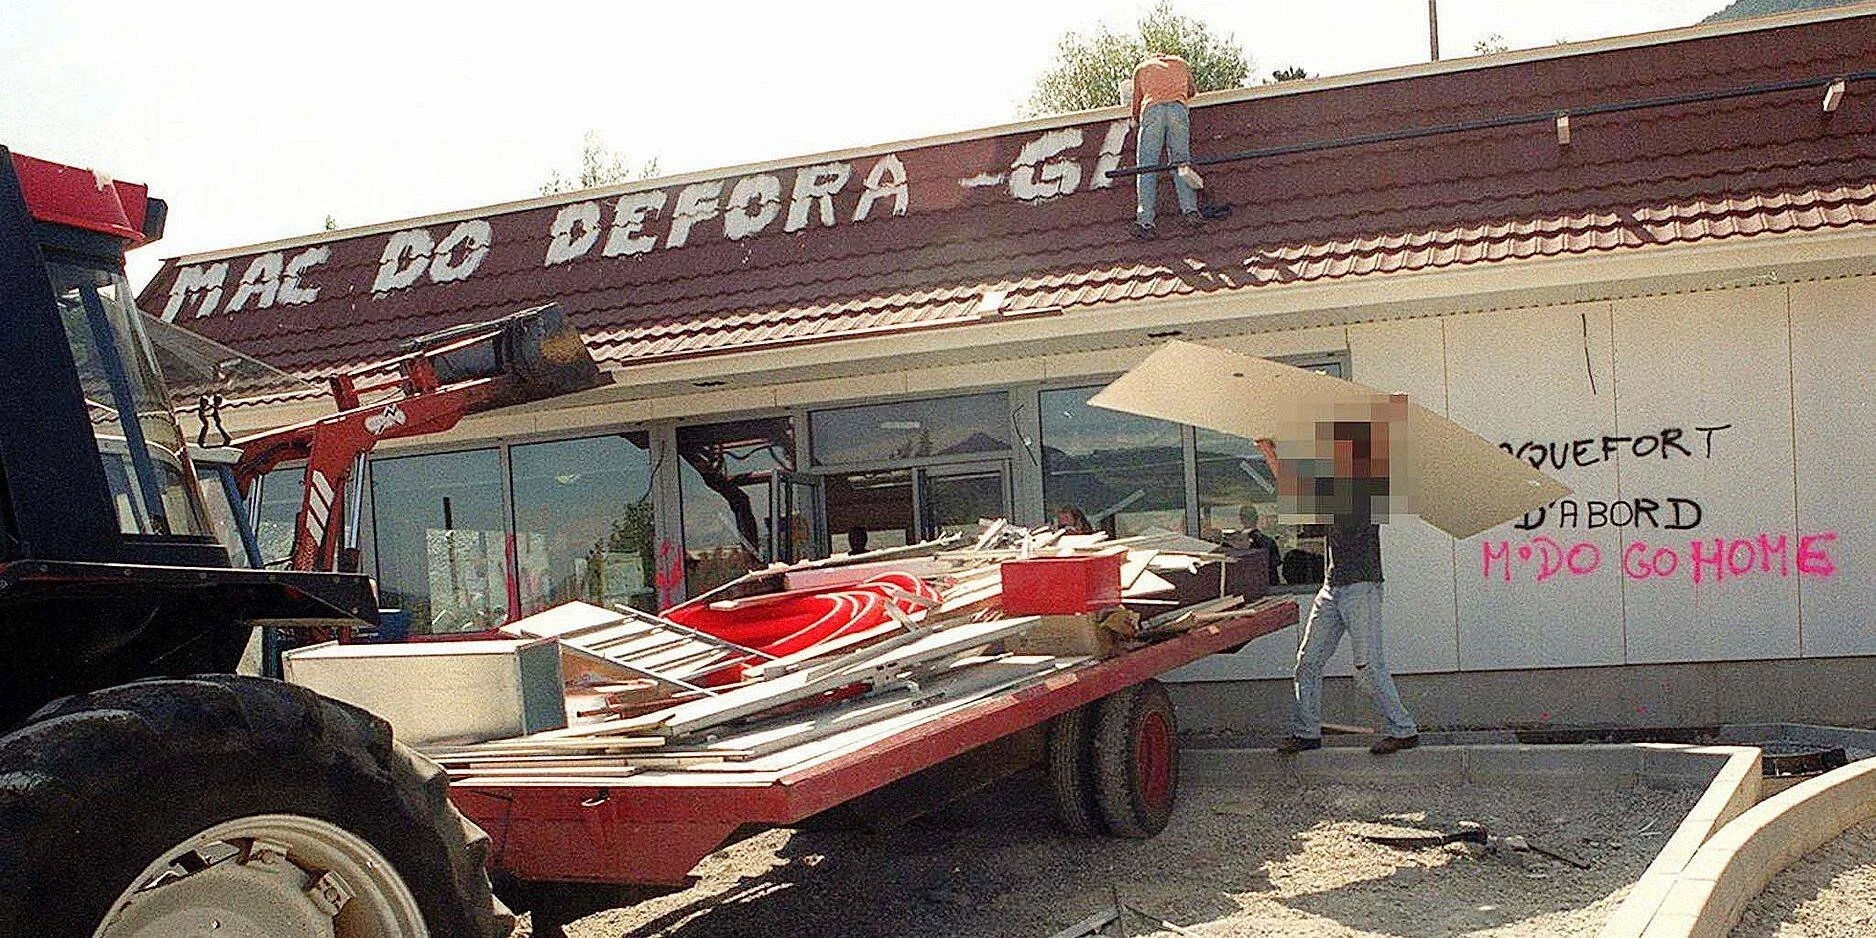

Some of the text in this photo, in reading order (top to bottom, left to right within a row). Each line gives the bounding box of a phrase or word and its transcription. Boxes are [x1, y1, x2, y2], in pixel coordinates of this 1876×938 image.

[159, 243, 332, 324] MAC
[371, 219, 493, 301] DO
[544, 152, 909, 268] DEFORA
[1624, 540, 1680, 580] GO
[1690, 530, 1840, 586] HOME
